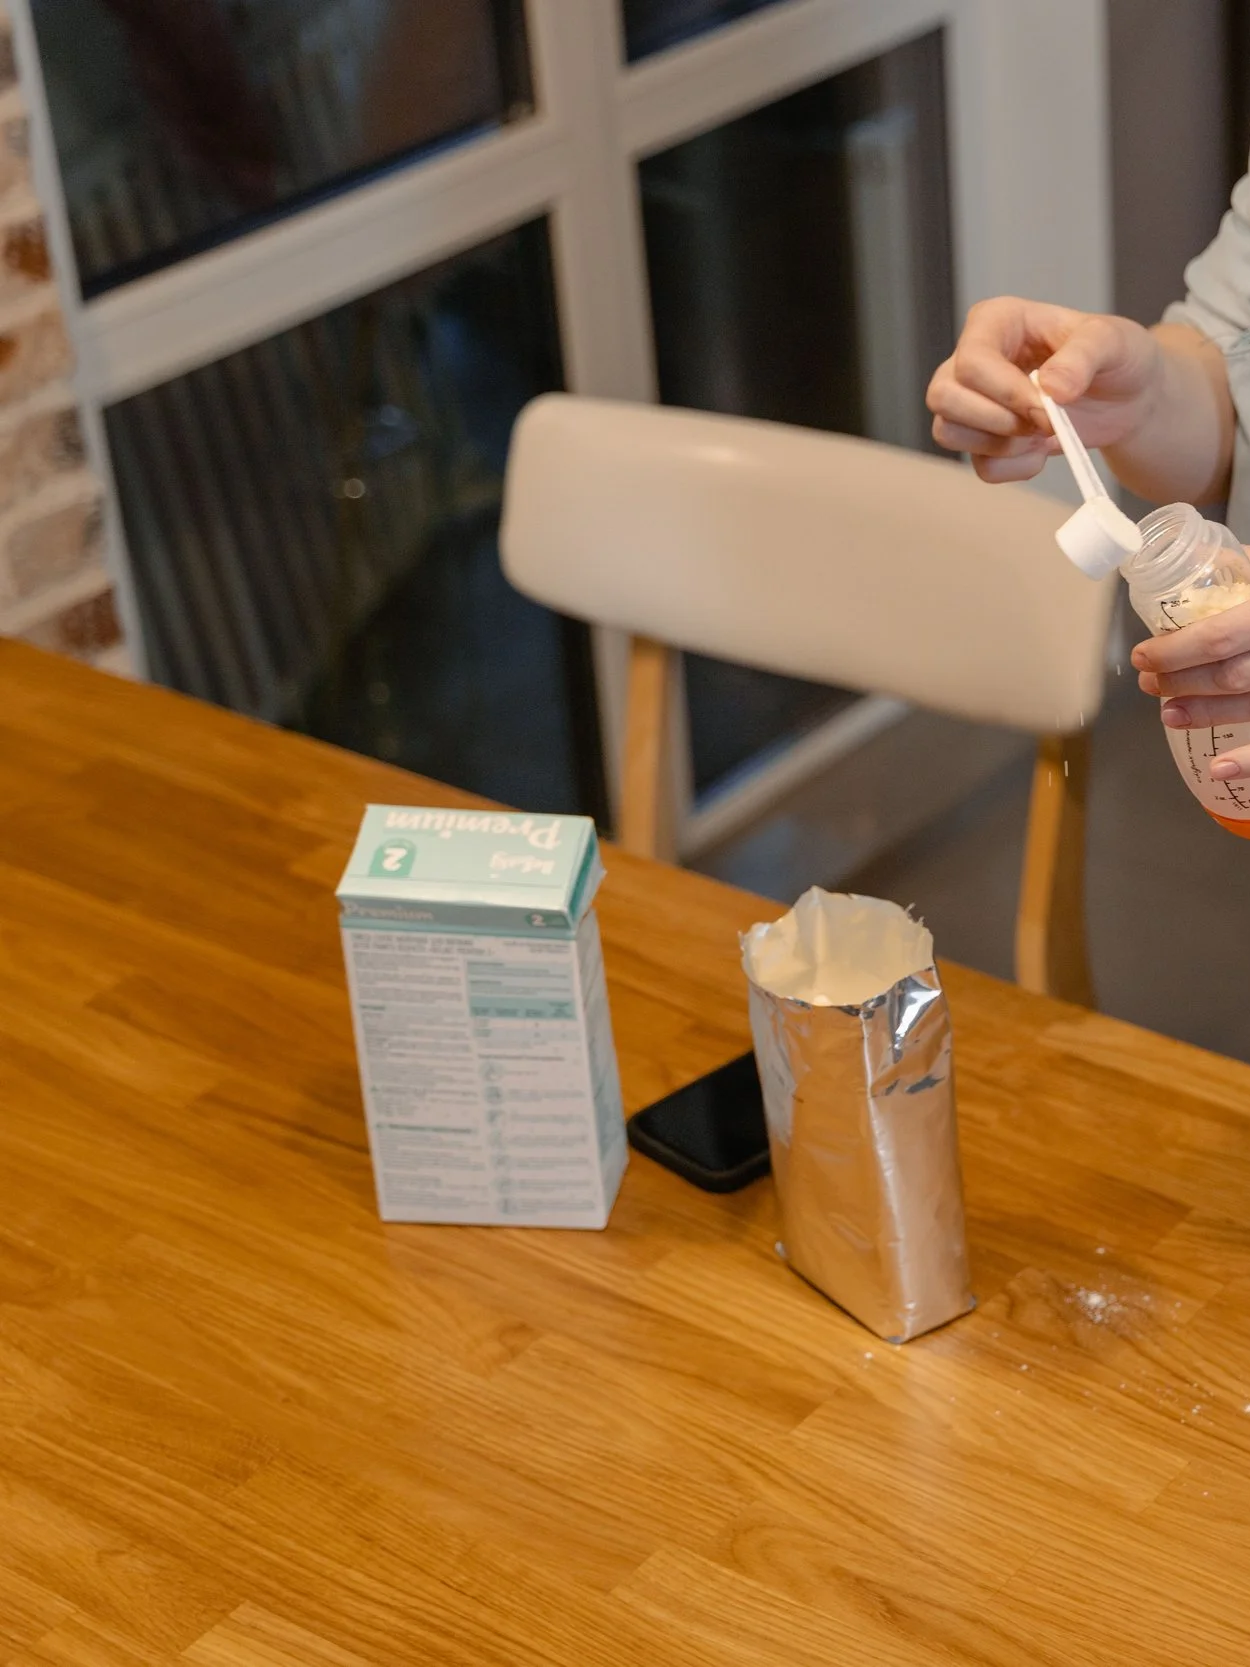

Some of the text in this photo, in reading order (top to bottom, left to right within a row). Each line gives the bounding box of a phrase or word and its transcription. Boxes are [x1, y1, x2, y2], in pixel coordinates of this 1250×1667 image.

[385, 810, 562, 850] Premium
[381, 847, 408, 872] 2
[531, 913, 546, 927] 2
